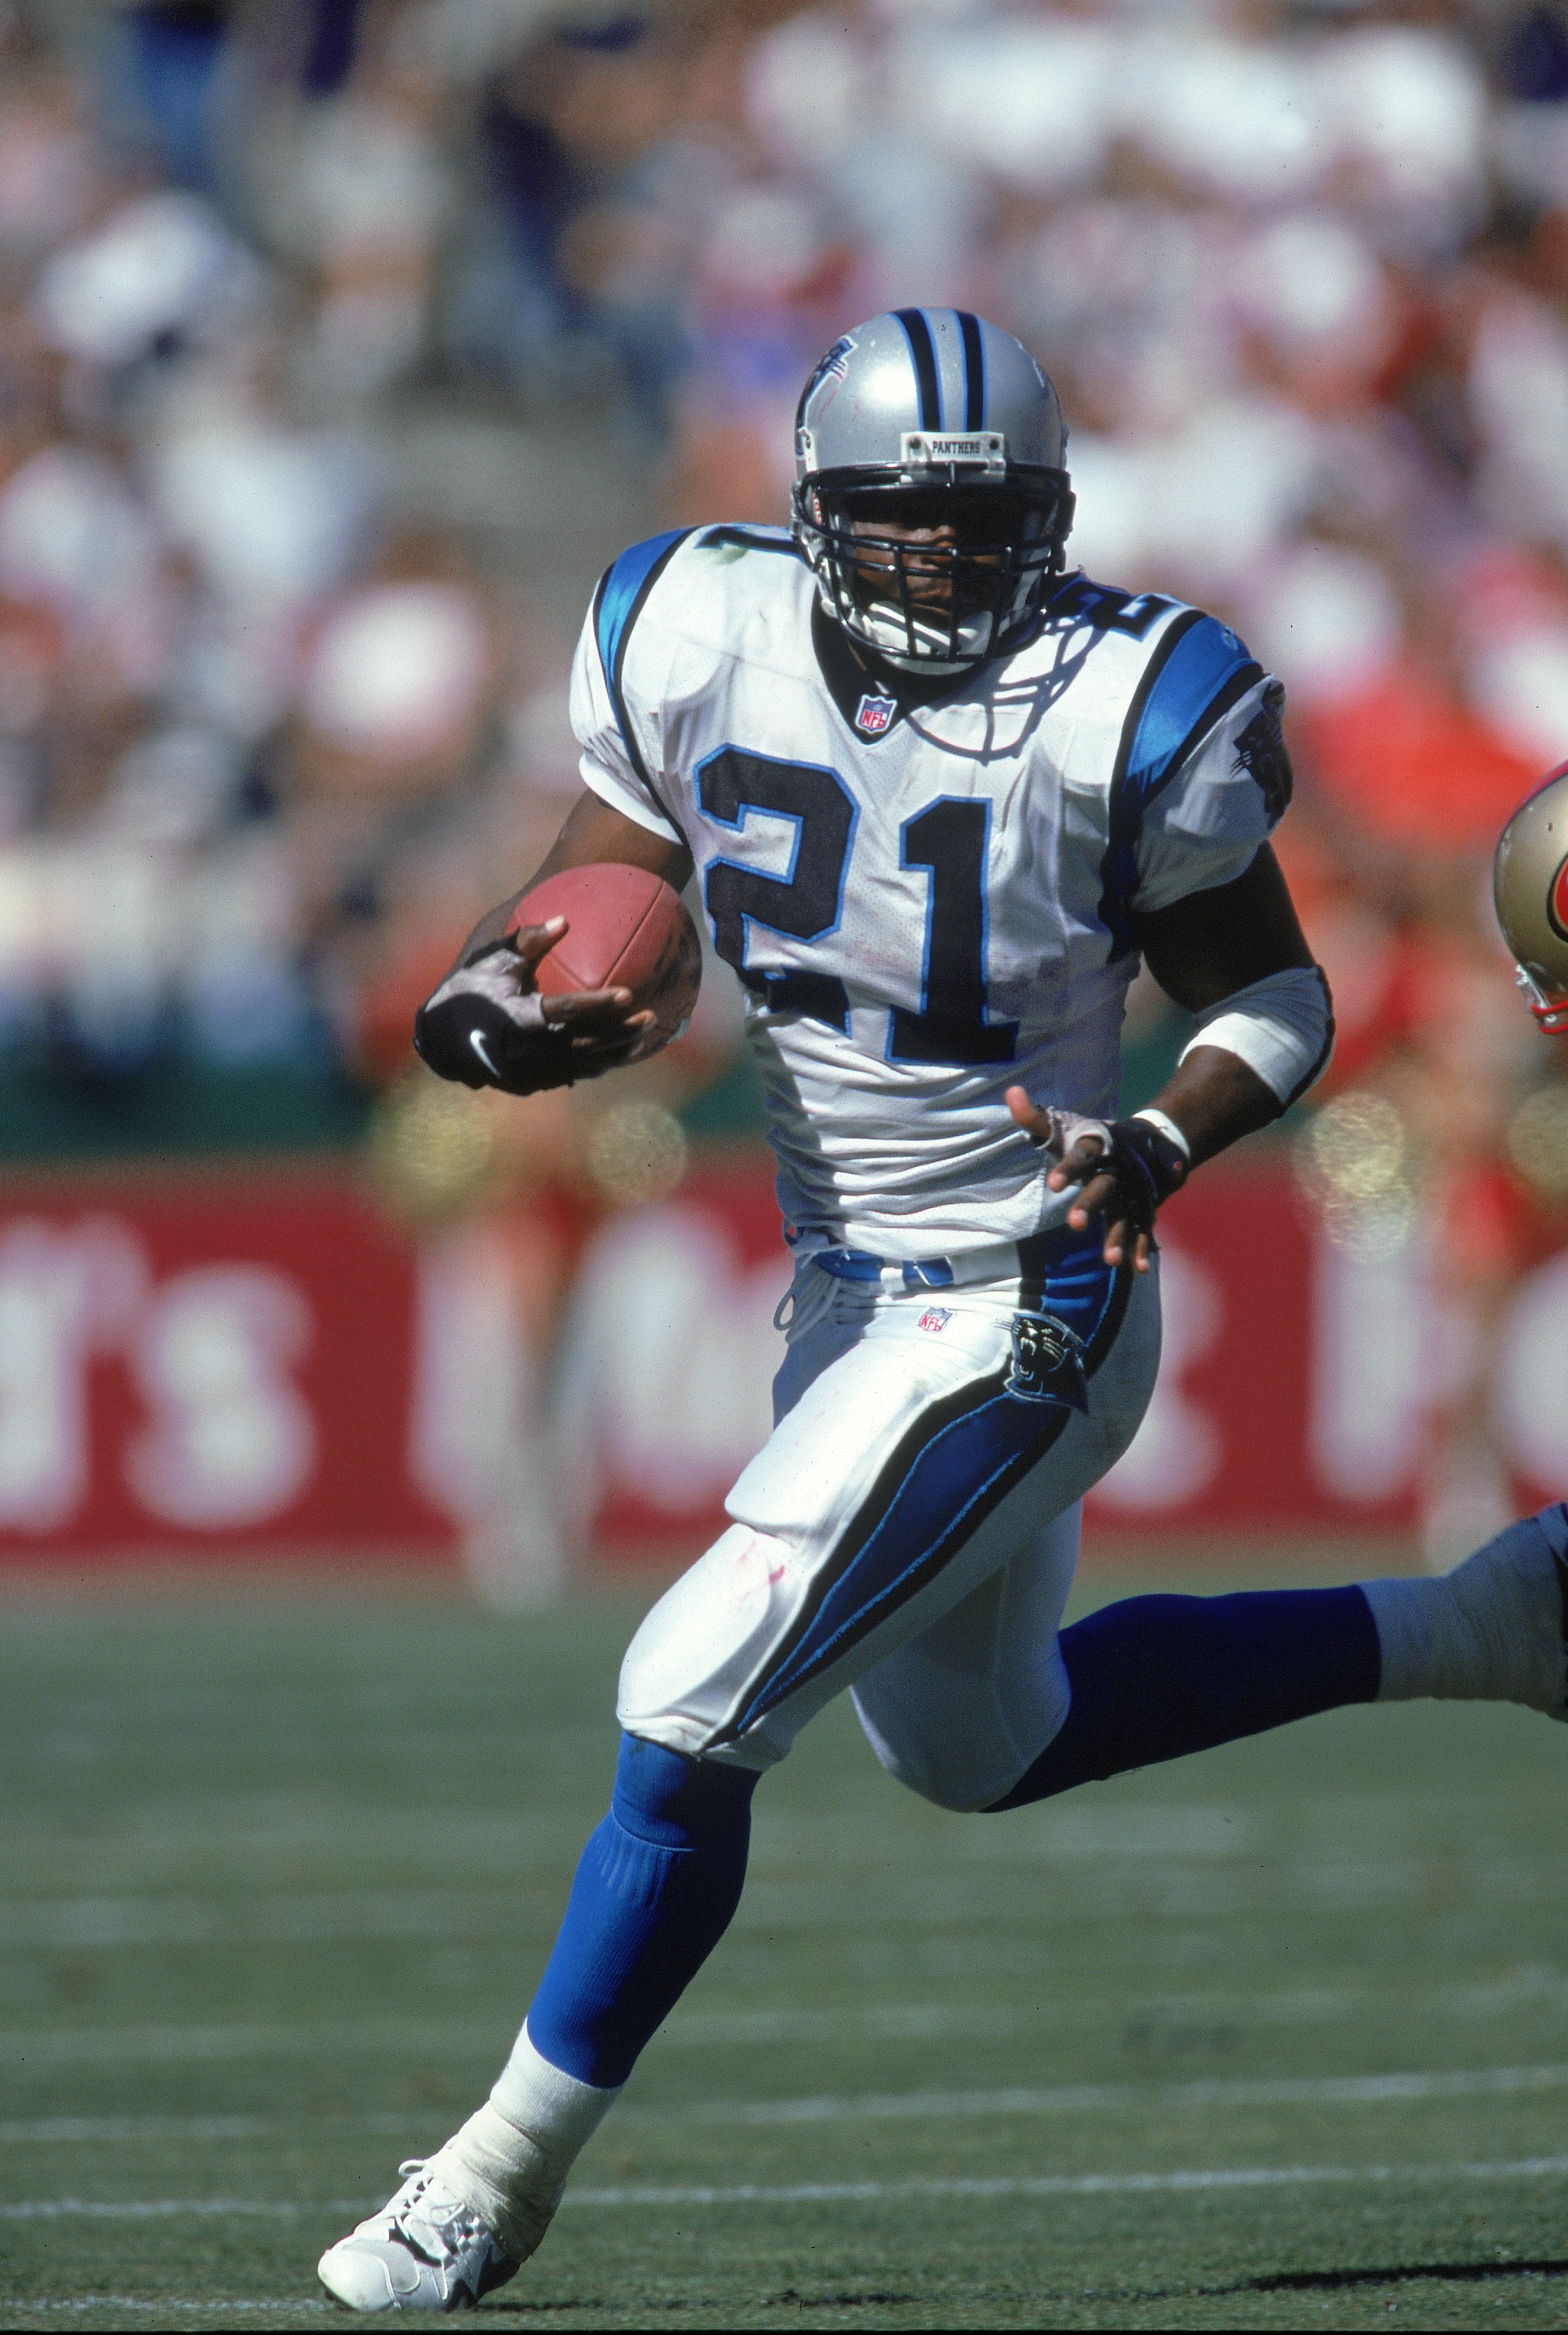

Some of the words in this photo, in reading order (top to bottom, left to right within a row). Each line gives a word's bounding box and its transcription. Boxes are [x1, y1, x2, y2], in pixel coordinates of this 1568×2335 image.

[932, 440, 980, 453] PANTHERS
[861, 710, 887, 729] NFL
[694, 742, 1020, 1065] 21
[921, 1314, 942, 1332] NFL
